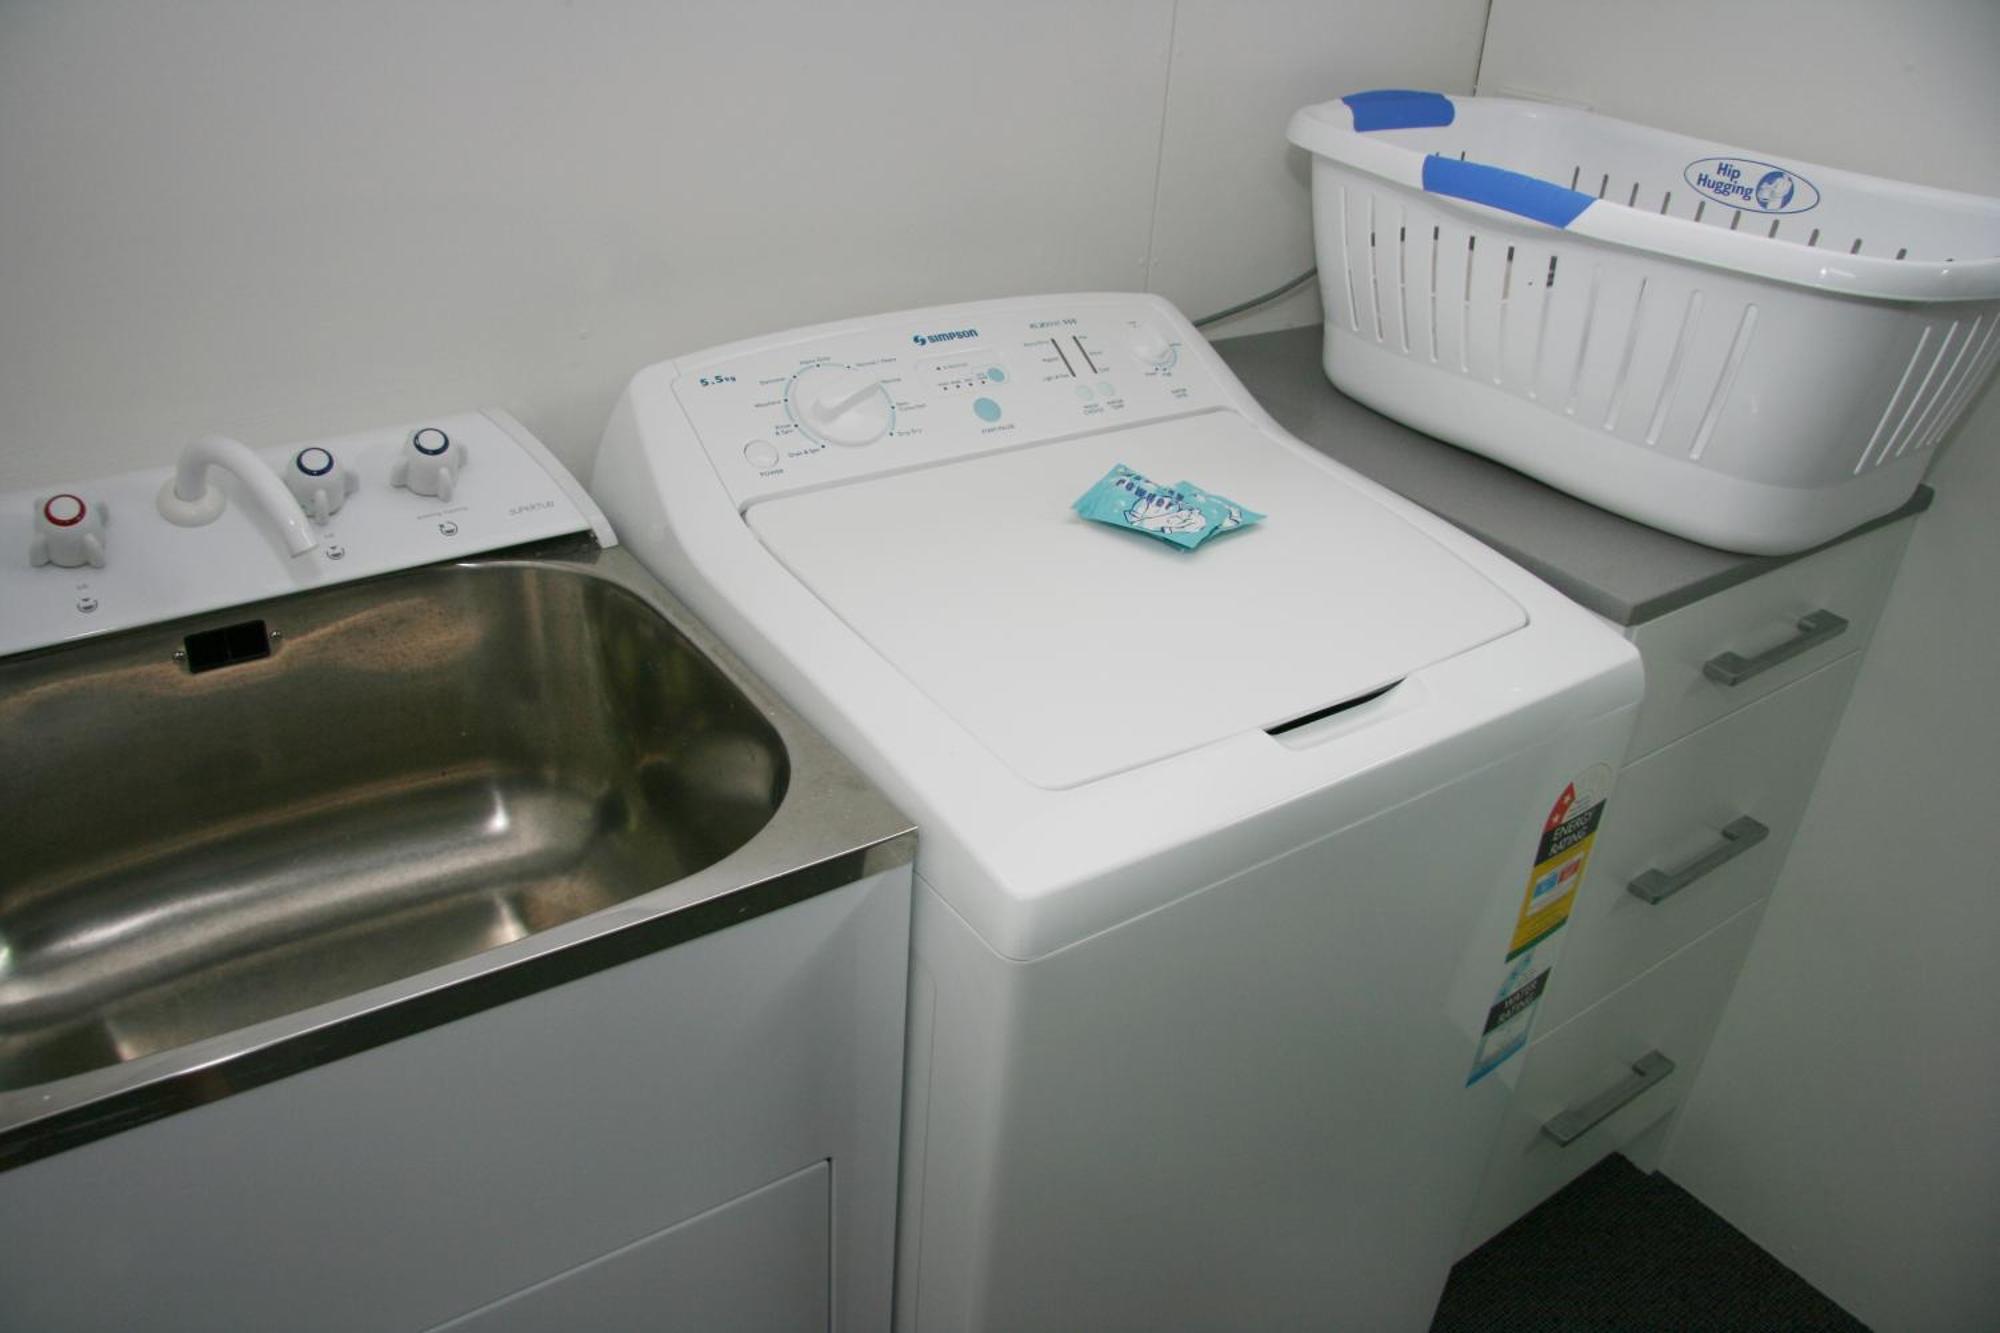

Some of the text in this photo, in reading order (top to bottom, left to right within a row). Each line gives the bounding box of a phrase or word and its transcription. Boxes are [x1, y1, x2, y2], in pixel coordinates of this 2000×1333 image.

[1716, 162, 1741, 182] Hip
[1696, 173, 1754, 201] Hugging
[927, 328, 979, 344] SIMPSON
